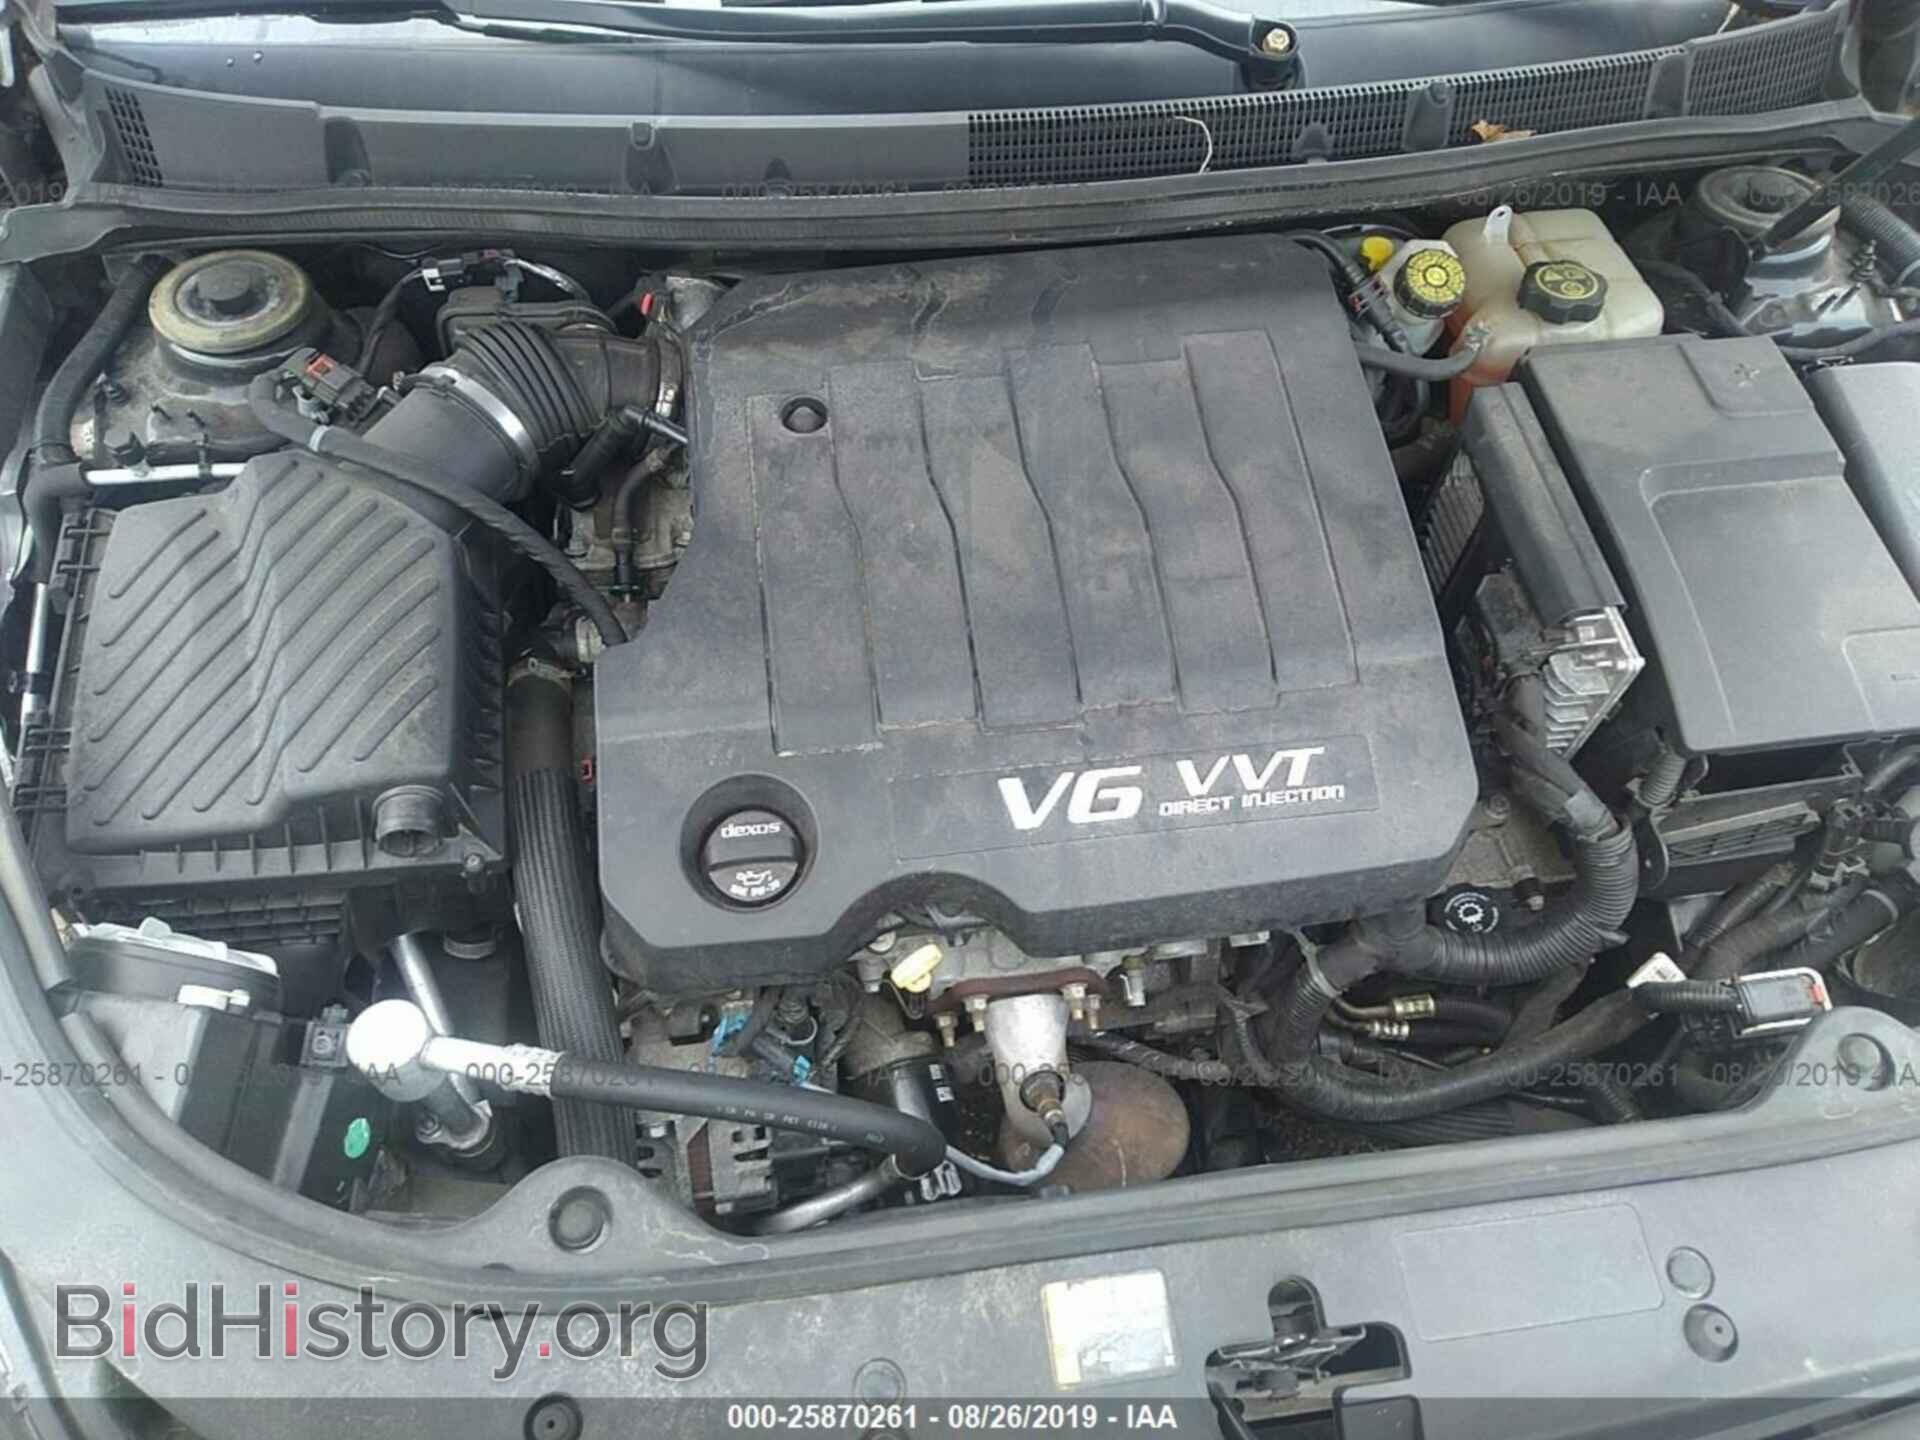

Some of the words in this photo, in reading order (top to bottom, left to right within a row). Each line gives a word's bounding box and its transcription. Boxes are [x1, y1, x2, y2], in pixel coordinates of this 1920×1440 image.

[997, 765, 1144, 831] V6
[1175, 745, 1326, 798] VVT
[1158, 795, 1235, 817] DIRECT
[720, 822, 782, 839] dexos
